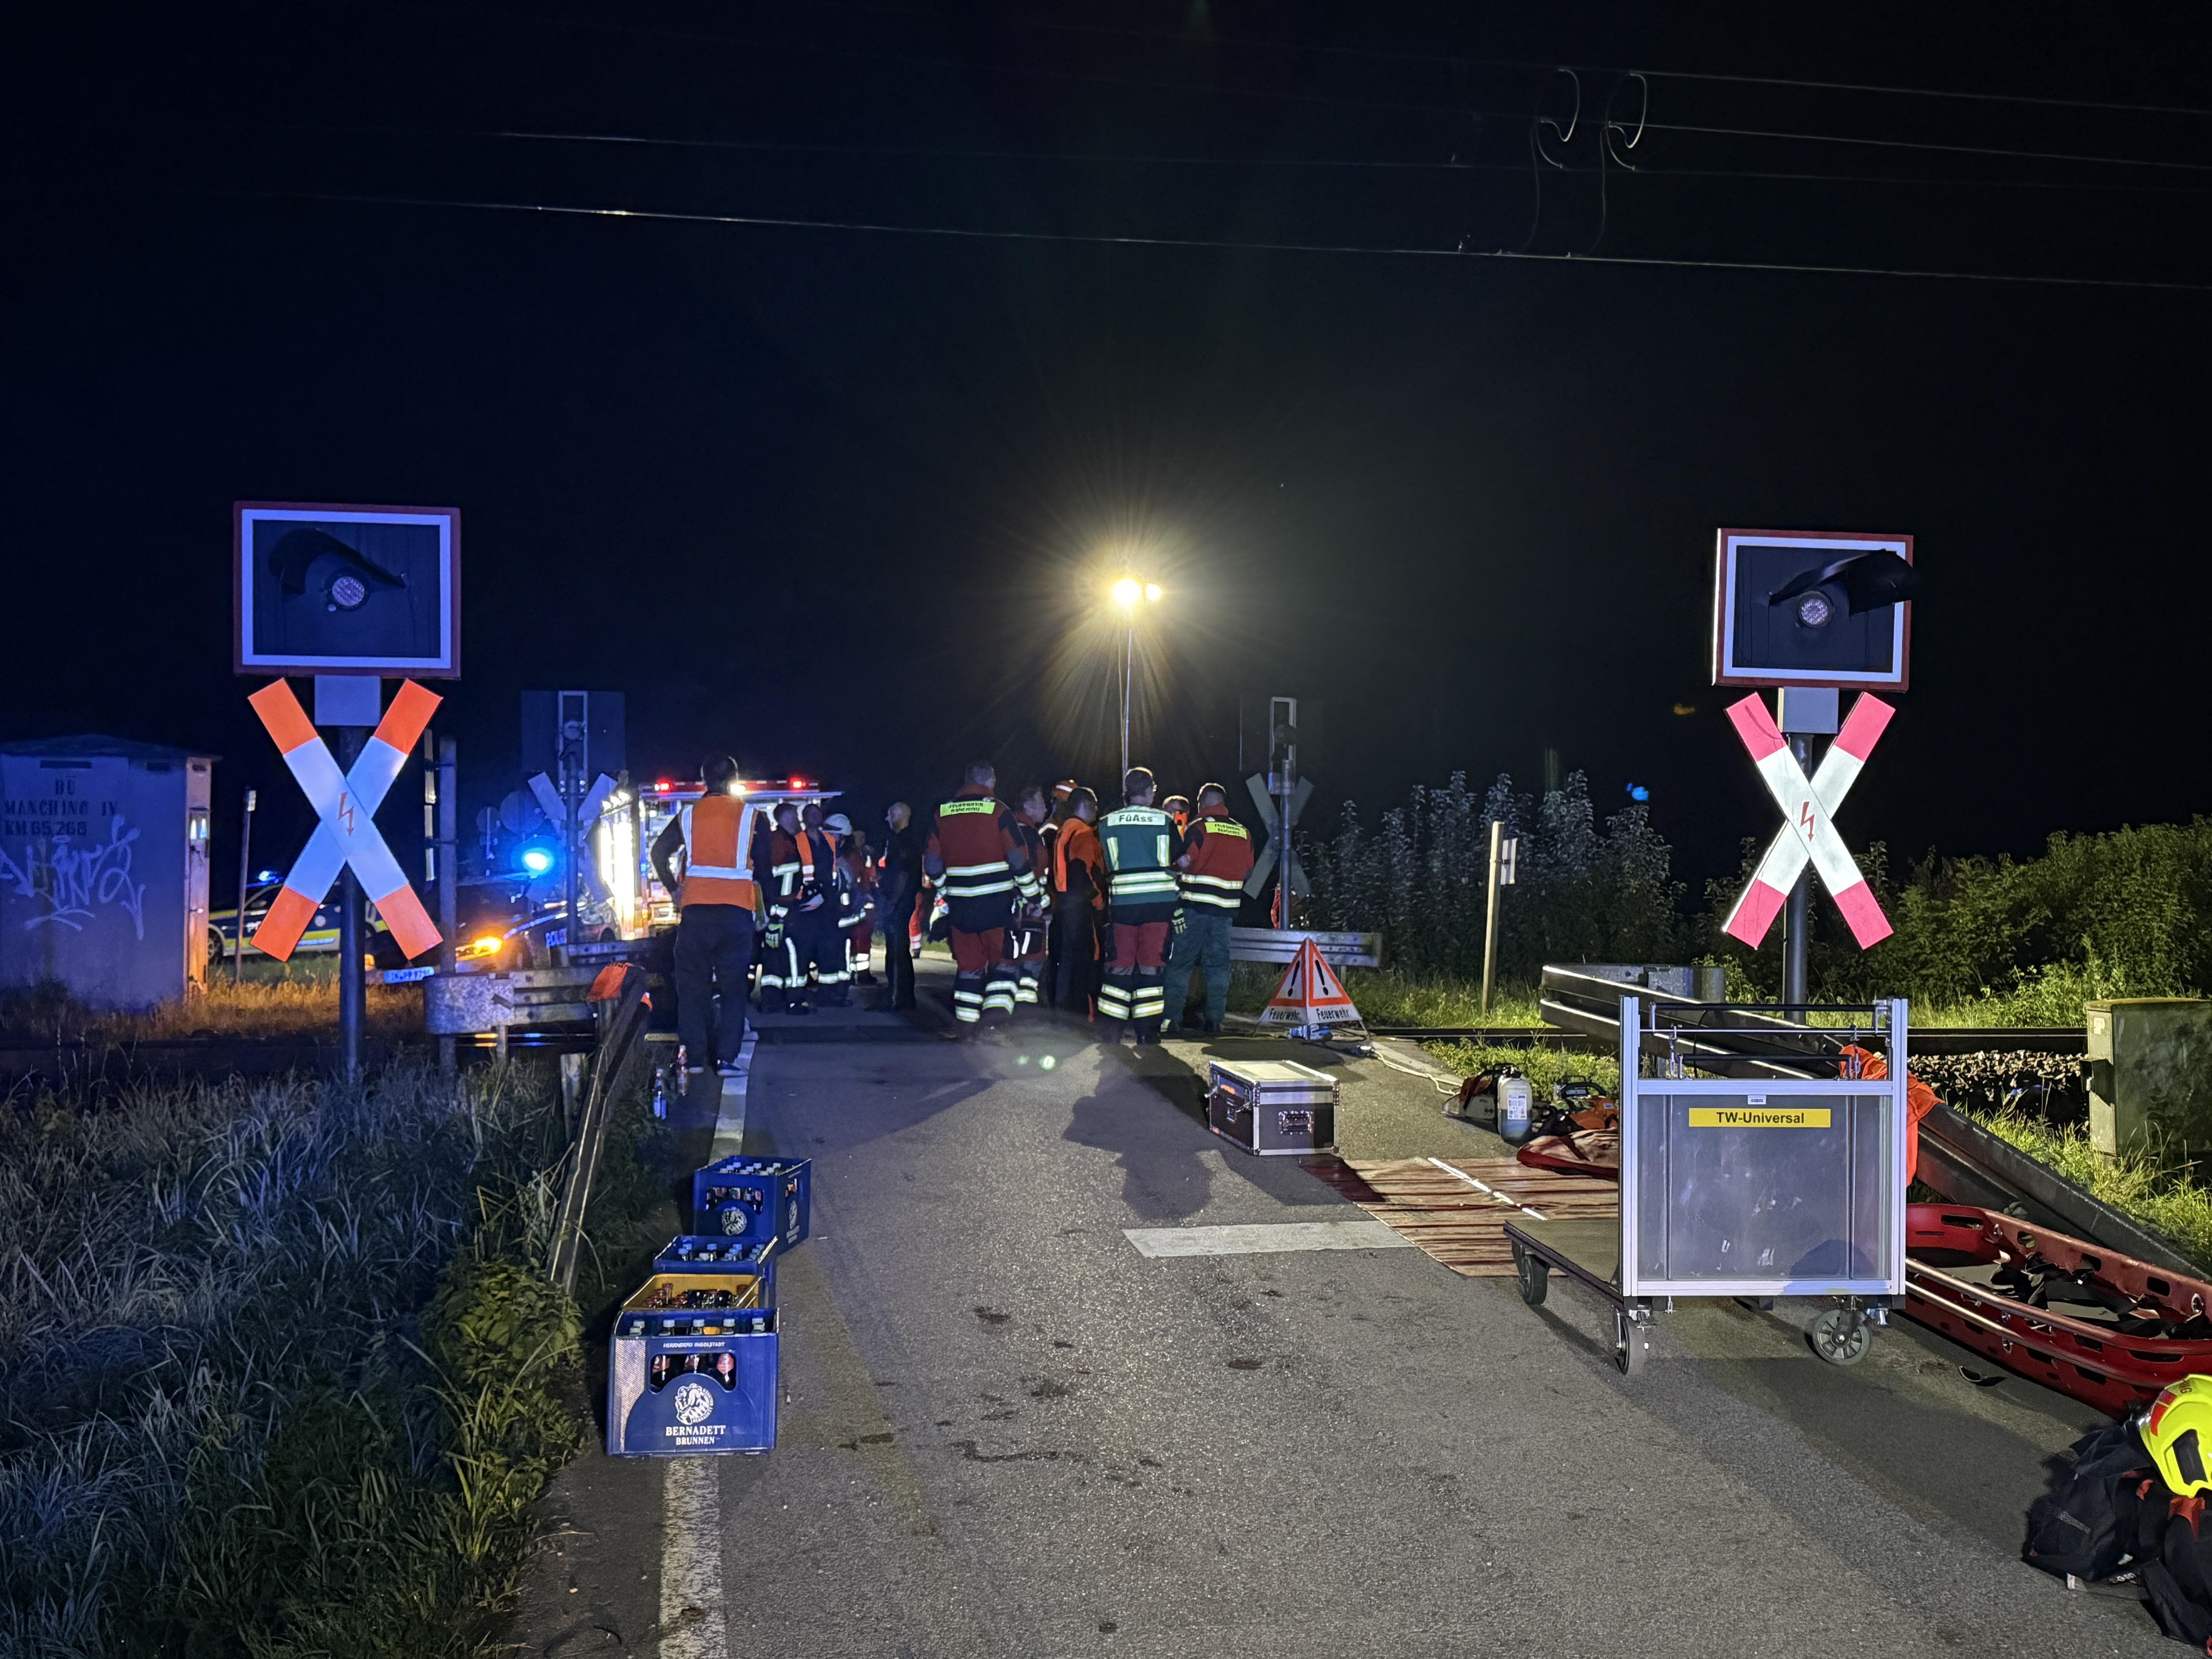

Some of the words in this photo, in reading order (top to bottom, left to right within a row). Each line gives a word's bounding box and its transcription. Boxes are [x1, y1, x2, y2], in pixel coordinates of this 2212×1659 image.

[1269, 1008, 1300, 1020] Feuerwehr
[1316, 1008, 1350, 1020] Feuerwehr
[1716, 1112, 1804, 1123] TW-Universal
[665, 1425, 726, 1436] BERNADETT
[676, 1436, 715, 1446] BRUNNEN
